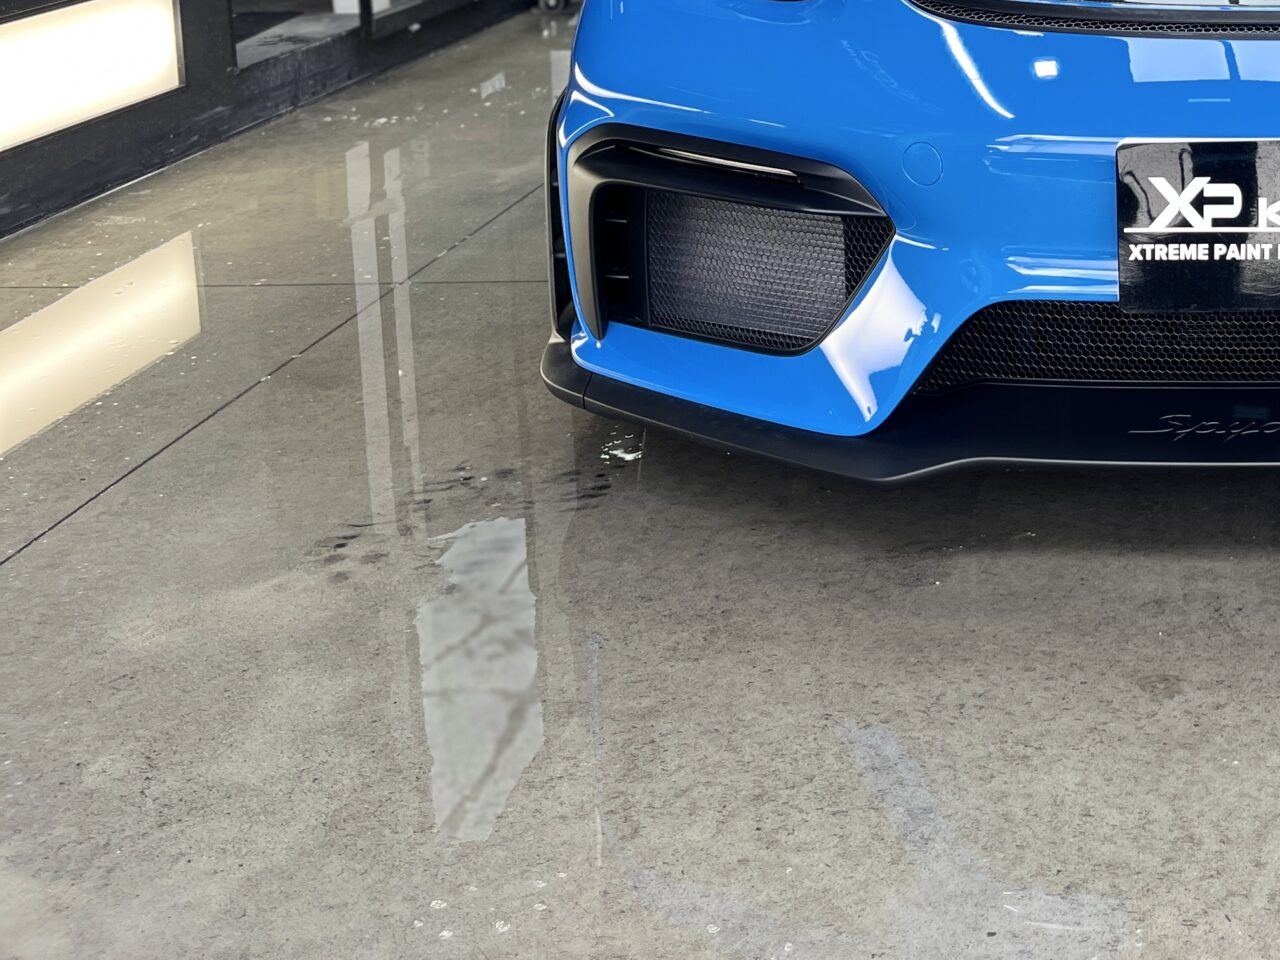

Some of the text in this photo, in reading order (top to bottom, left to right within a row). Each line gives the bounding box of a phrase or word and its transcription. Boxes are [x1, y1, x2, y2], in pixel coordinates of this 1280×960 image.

[1147, 176, 1243, 228] XP
[1129, 244, 1209, 261] XTREME
[1214, 244, 1272, 261] PAINT
